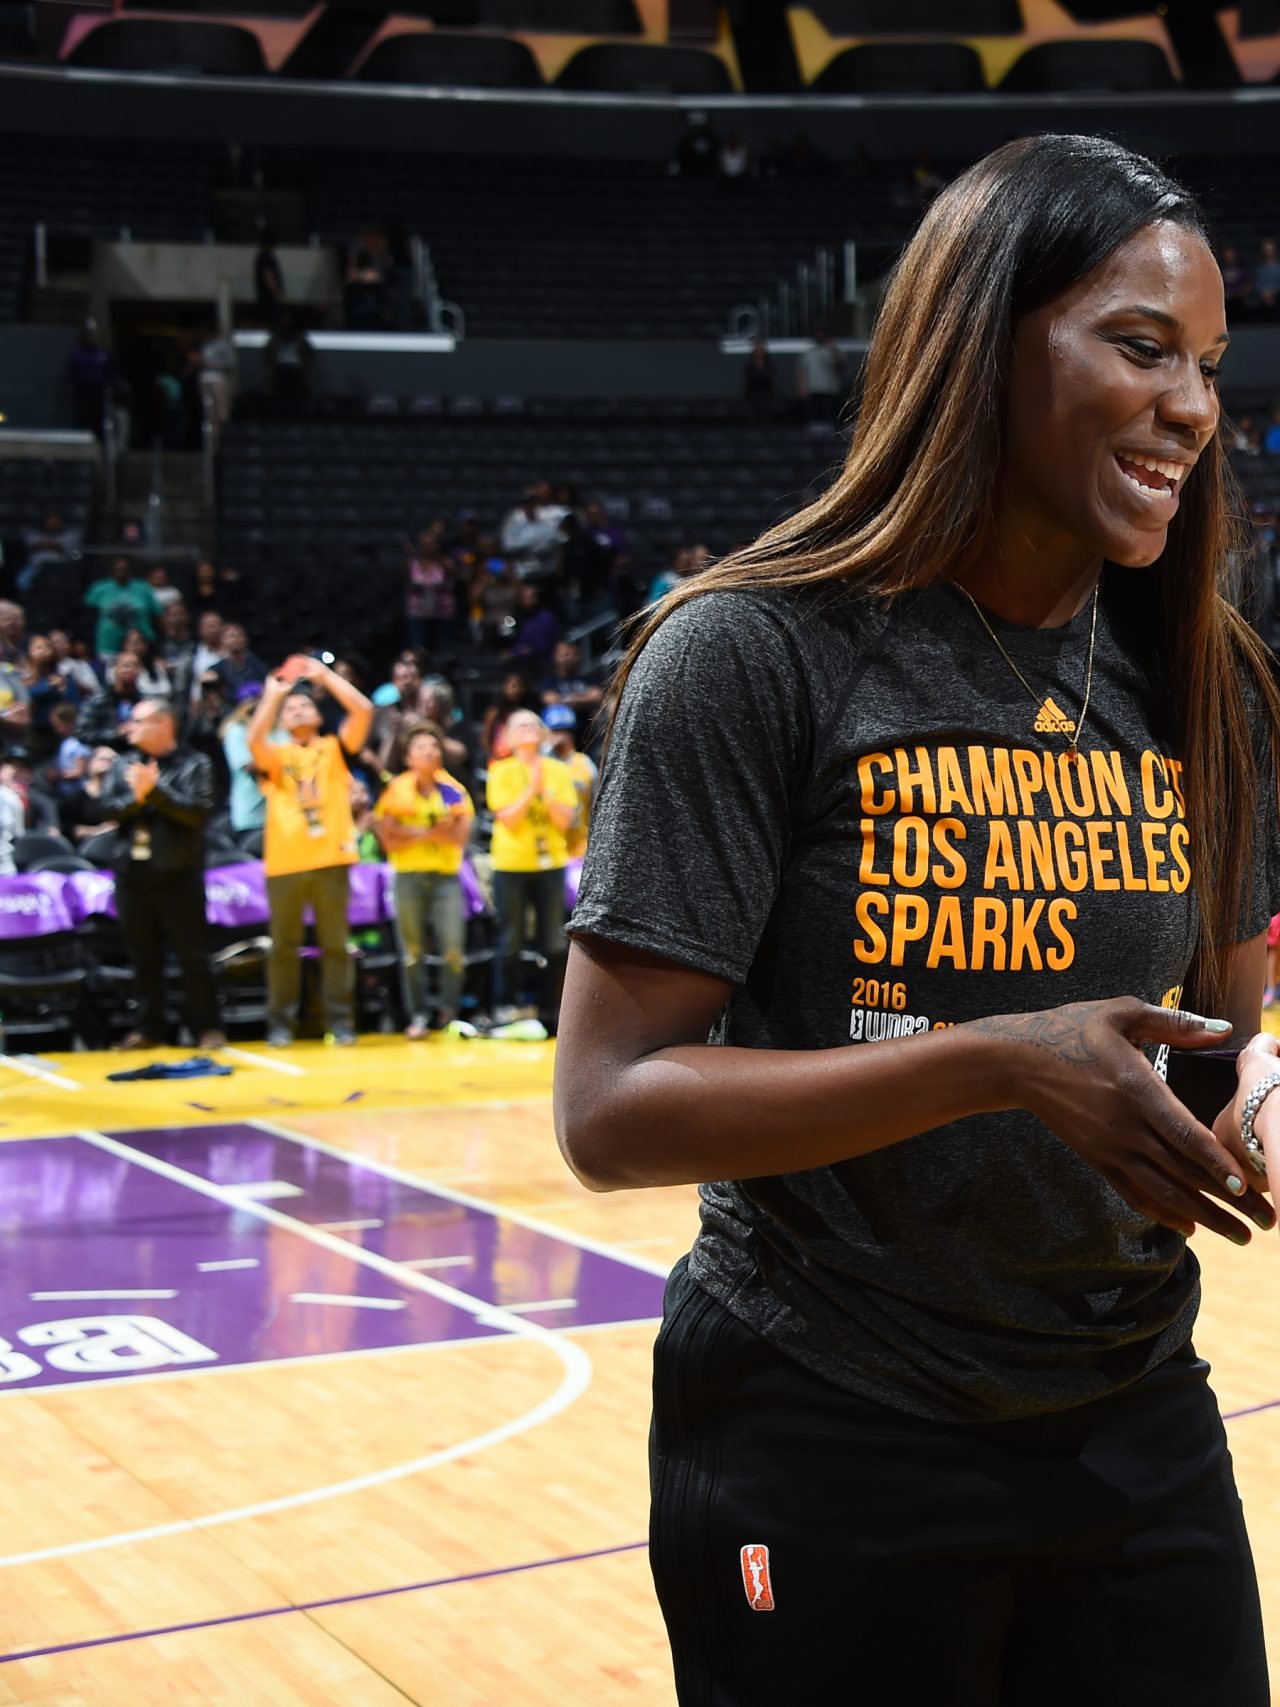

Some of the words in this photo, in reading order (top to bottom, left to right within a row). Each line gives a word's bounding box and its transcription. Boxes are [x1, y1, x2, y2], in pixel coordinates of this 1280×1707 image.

[1034, 719, 1076, 732] adidas
[857, 745, 1132, 818] CHAMPION
[858, 816, 967, 889] LOS
[983, 820, 1191, 894] ANGELES
[853, 891, 1078, 972] SPARKS
[851, 977, 907, 1011] 2016
